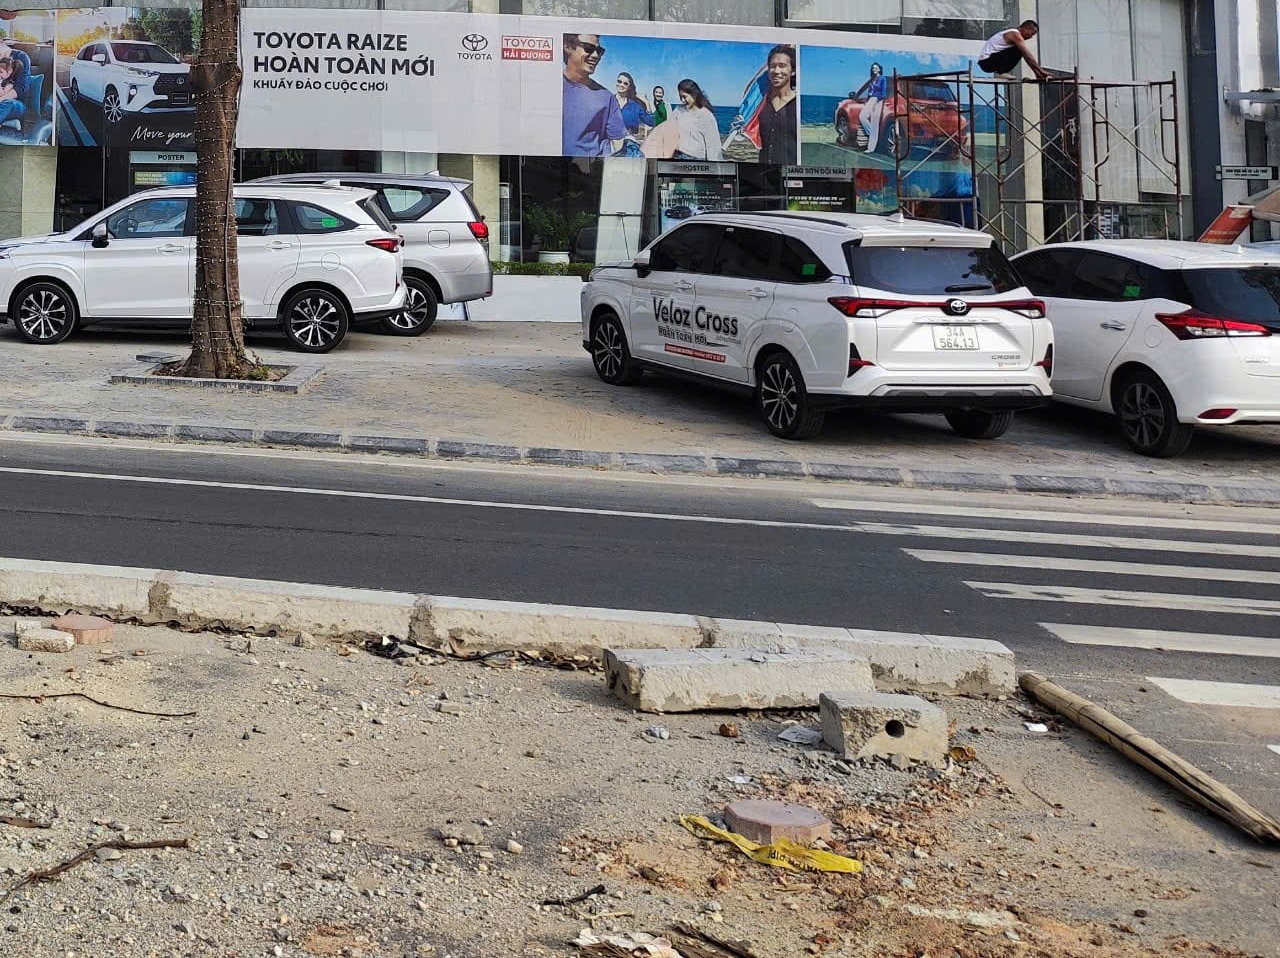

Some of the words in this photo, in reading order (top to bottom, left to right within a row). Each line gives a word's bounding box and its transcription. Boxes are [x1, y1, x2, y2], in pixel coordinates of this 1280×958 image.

[253, 31, 342, 50] TOYOTA
[347, 33, 408, 52] RAIZE
[503, 38, 551, 48] TOYOTA
[254, 52, 319, 74] HOÀN
[324, 53, 386, 75] TOÀN
[391, 54, 435, 77] MỚI
[457, 52, 493, 61] TOYOTA
[324, 79, 358, 93] CUỘC
[360, 80, 389, 92] CHƠI
[130, 125, 166, 142] Move
[166, 132, 193, 146] your
[683, 164, 709, 172] POSTER
[653, 297, 691, 327] Veloz
[695, 304, 739, 336] Cross
